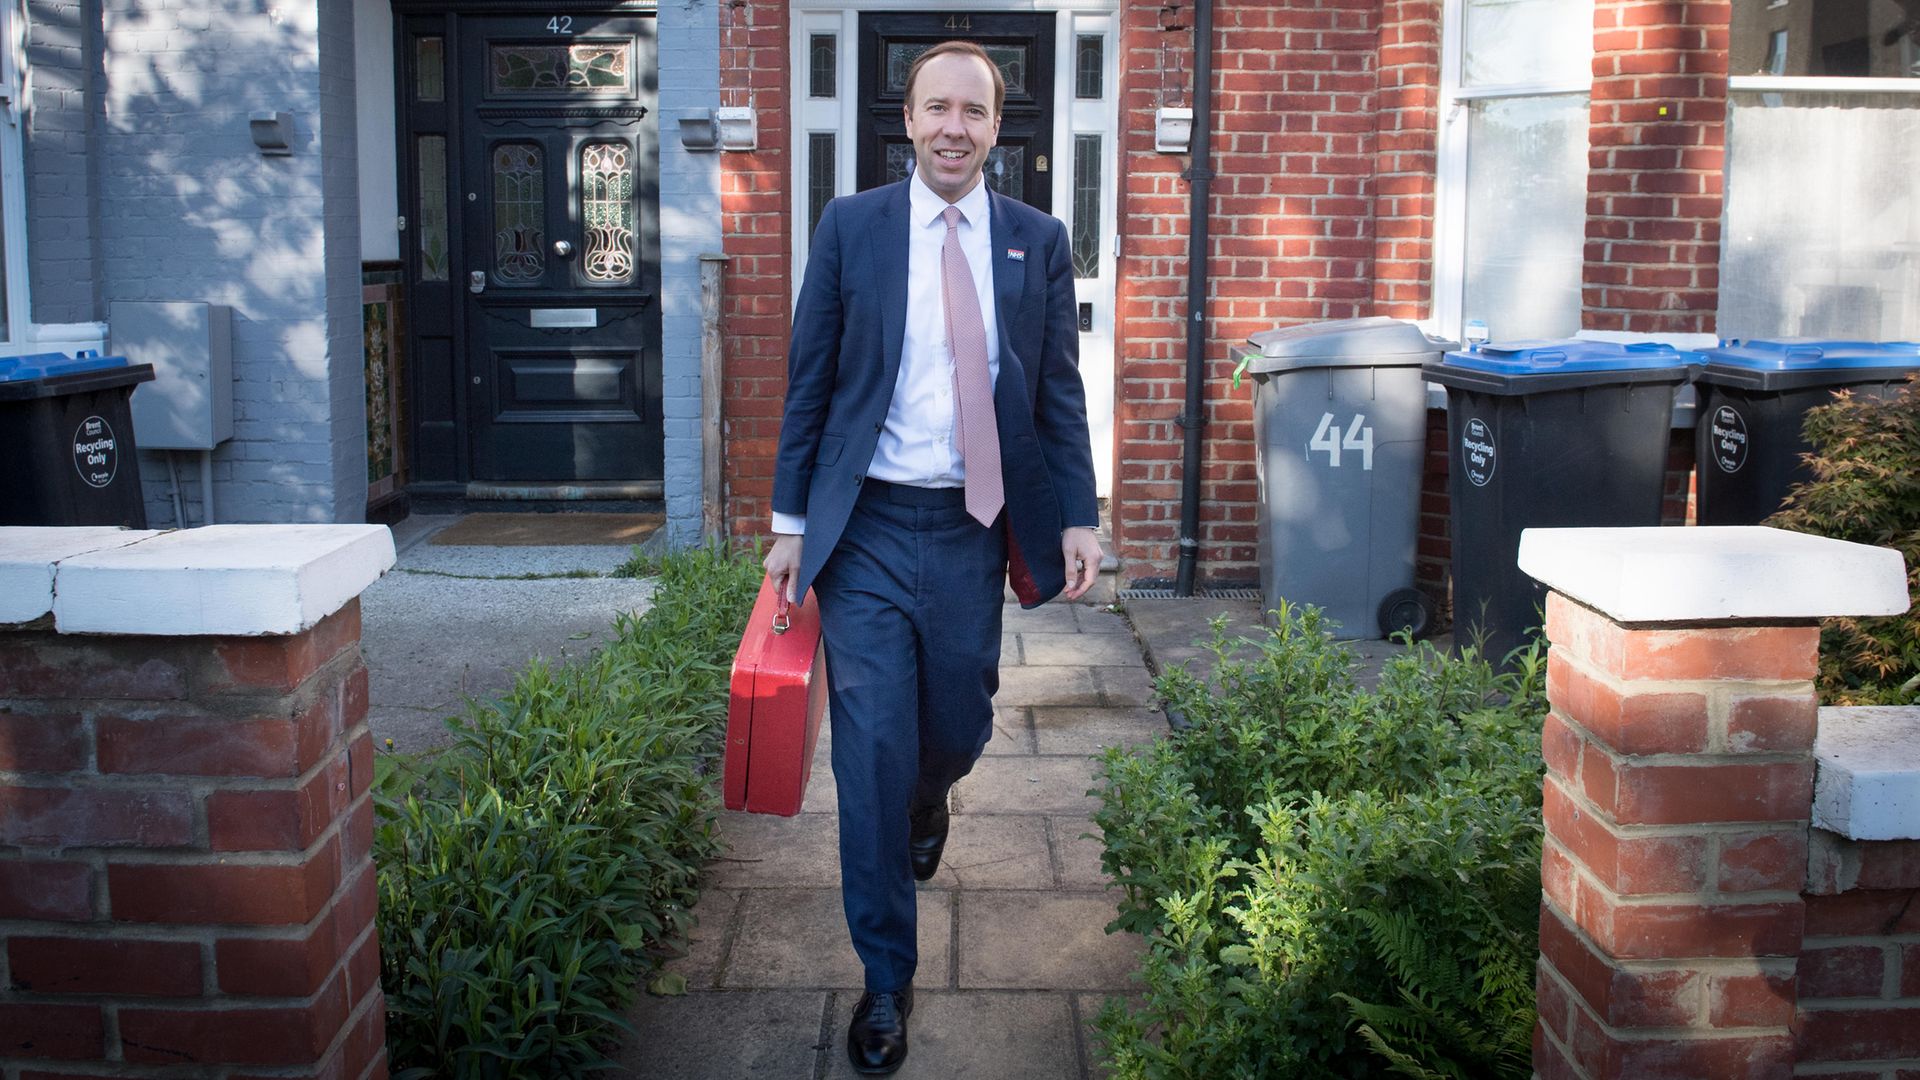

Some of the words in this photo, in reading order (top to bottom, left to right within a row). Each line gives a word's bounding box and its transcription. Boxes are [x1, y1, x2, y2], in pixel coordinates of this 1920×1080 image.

[546, 15, 573, 34] 42
[944, 14, 972, 31] 44
[85, 421, 102, 430] Brent
[1309, 411, 1374, 471] 44
[1713, 424, 1746, 444] Recycling
[75, 438, 114, 454] Recycling
[1464, 437, 1494, 457] Recycling
[1721, 439, 1738, 454] Only
[87, 452, 106, 465] Only
[1470, 452, 1486, 467] Only
